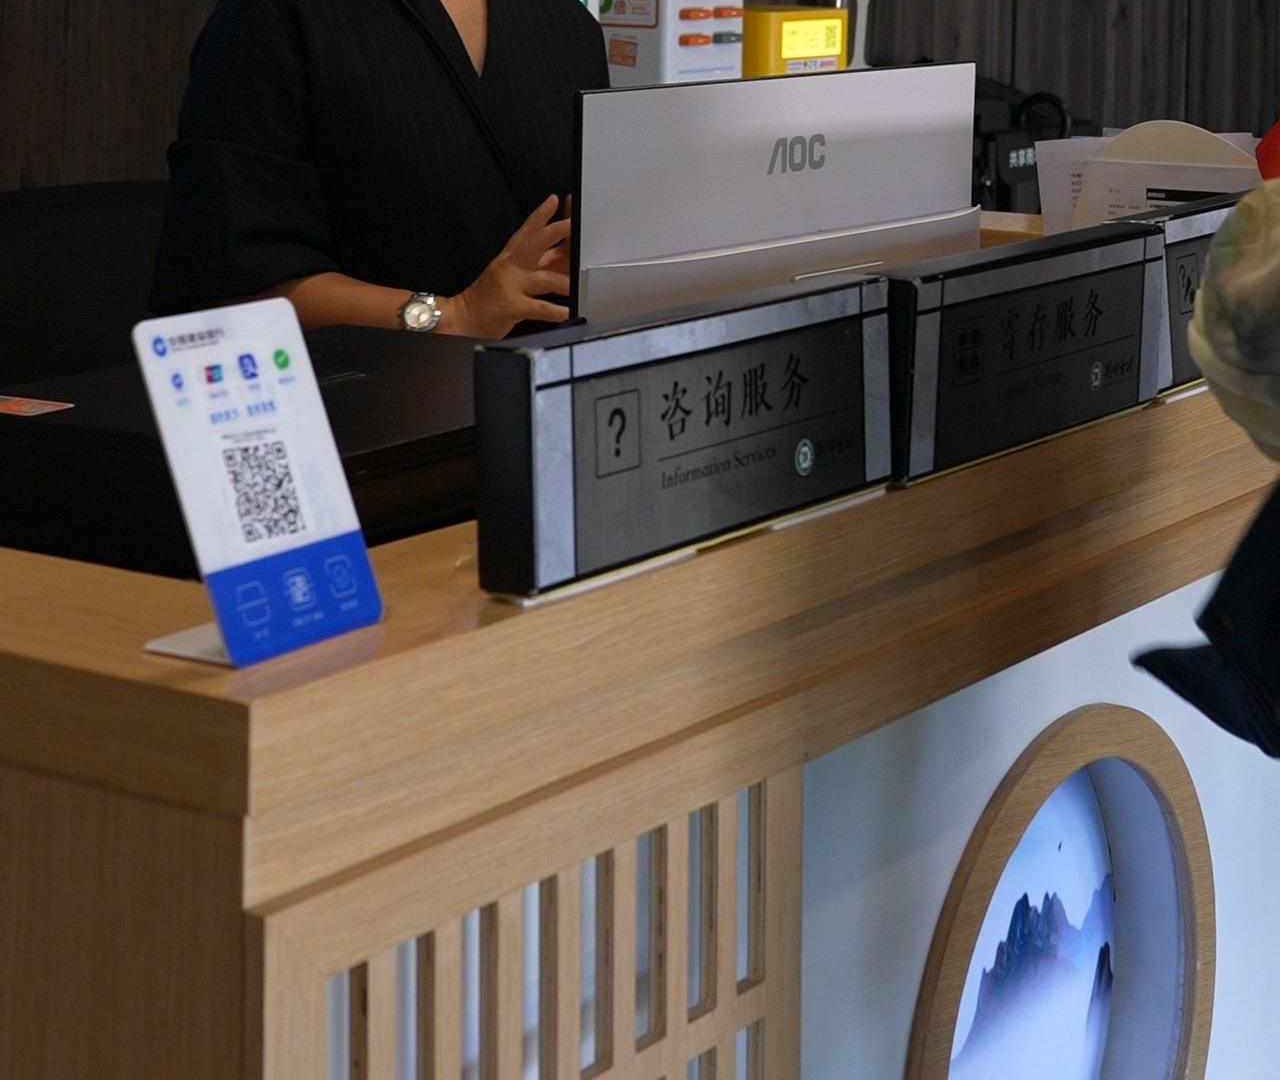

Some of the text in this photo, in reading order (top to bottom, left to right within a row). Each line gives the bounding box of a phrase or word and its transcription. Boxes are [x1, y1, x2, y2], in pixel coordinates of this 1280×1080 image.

[767, 133, 826, 175] AOC
[660, 352, 810, 441] 咨询服务
[661, 455, 732, 490] Information
